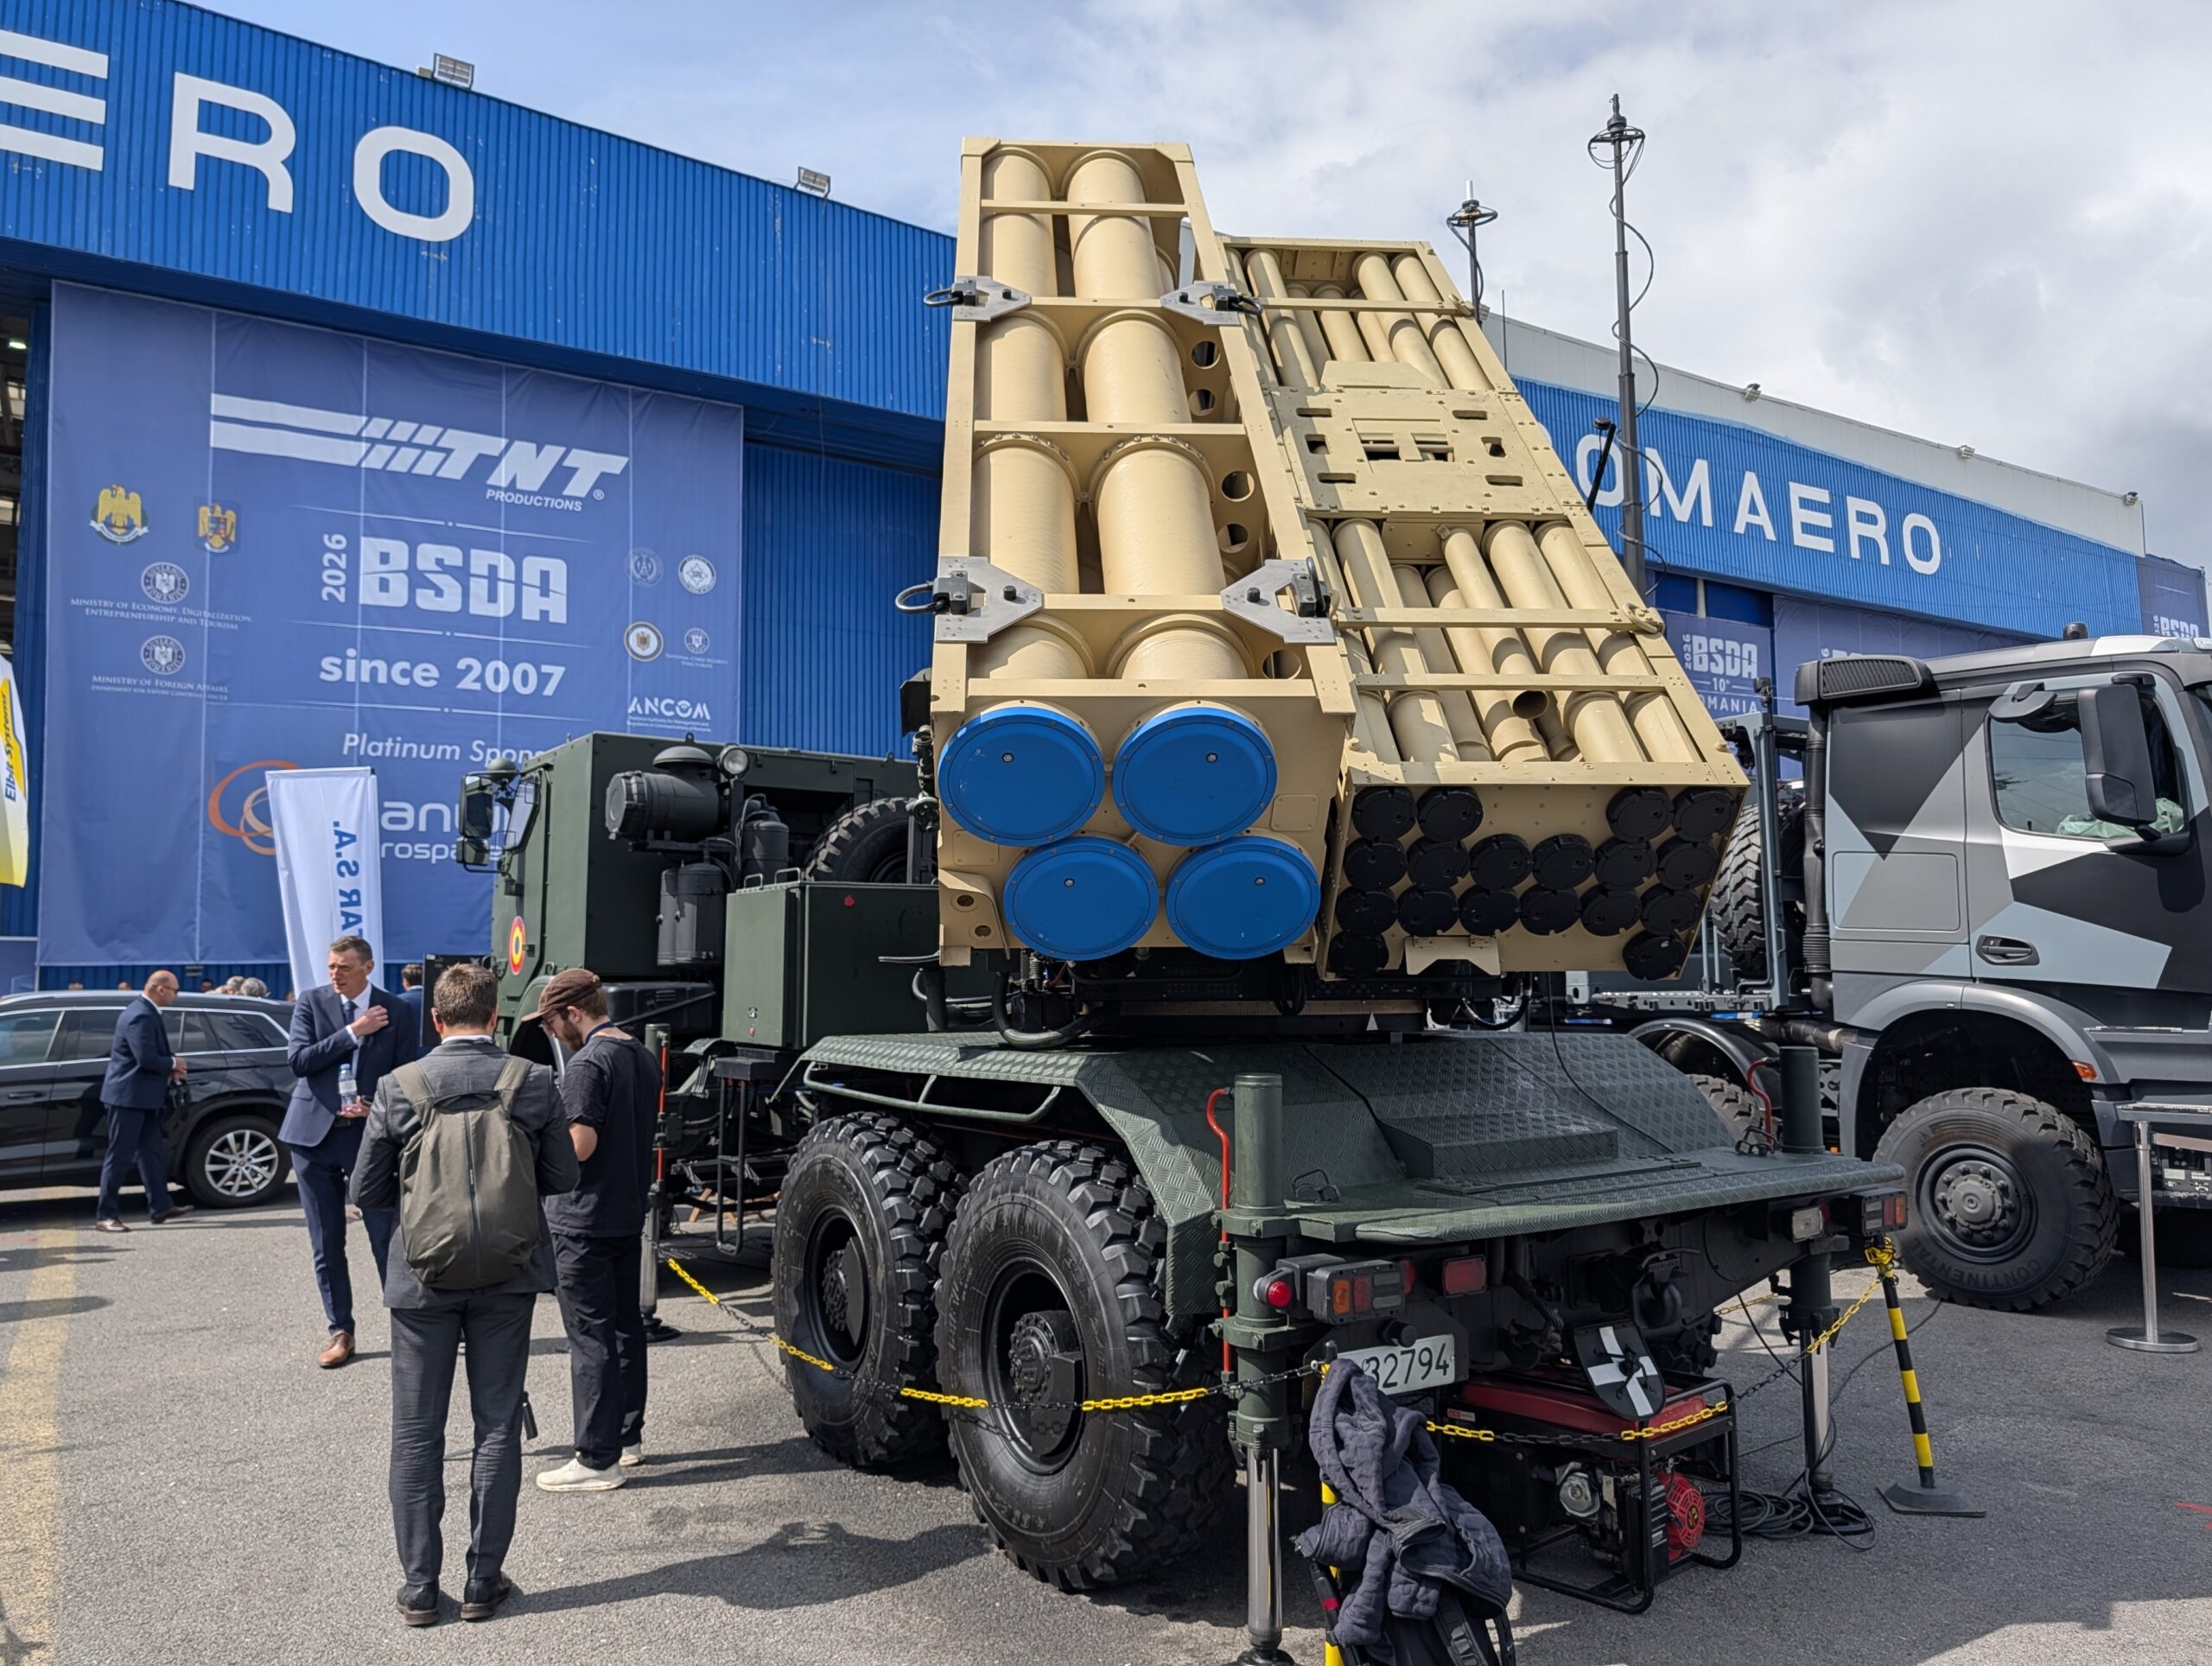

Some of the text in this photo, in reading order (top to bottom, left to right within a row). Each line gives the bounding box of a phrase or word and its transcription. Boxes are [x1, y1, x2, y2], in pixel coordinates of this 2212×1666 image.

[435, 428, 630, 499] TNT
[486, 488, 583, 512] PRODUCTIONS
[1538, 422, 1942, 575] OMAERO
[321, 532, 347, 603] 2026
[359, 536, 568, 625] BSDA
[71, 598, 114, 609] MINISTRY
[85, 608, 175, 622] ENTREPRENEURSHIP
[200, 618, 238, 630] TOURISM
[319, 648, 567, 697] since 2007
[1682, 633, 1691, 671] 2026
[1691, 634, 1758, 679] BSDA
[92, 675, 138, 684] MINISTRY
[155, 679, 194, 690] FOREIGN
[627, 696, 711, 721] ANCOM
[343, 732, 461, 761] Platinum
[1911, 1237, 2042, 1287] CONTINENTAL
[1365, 1342, 1450, 1389] 32794
